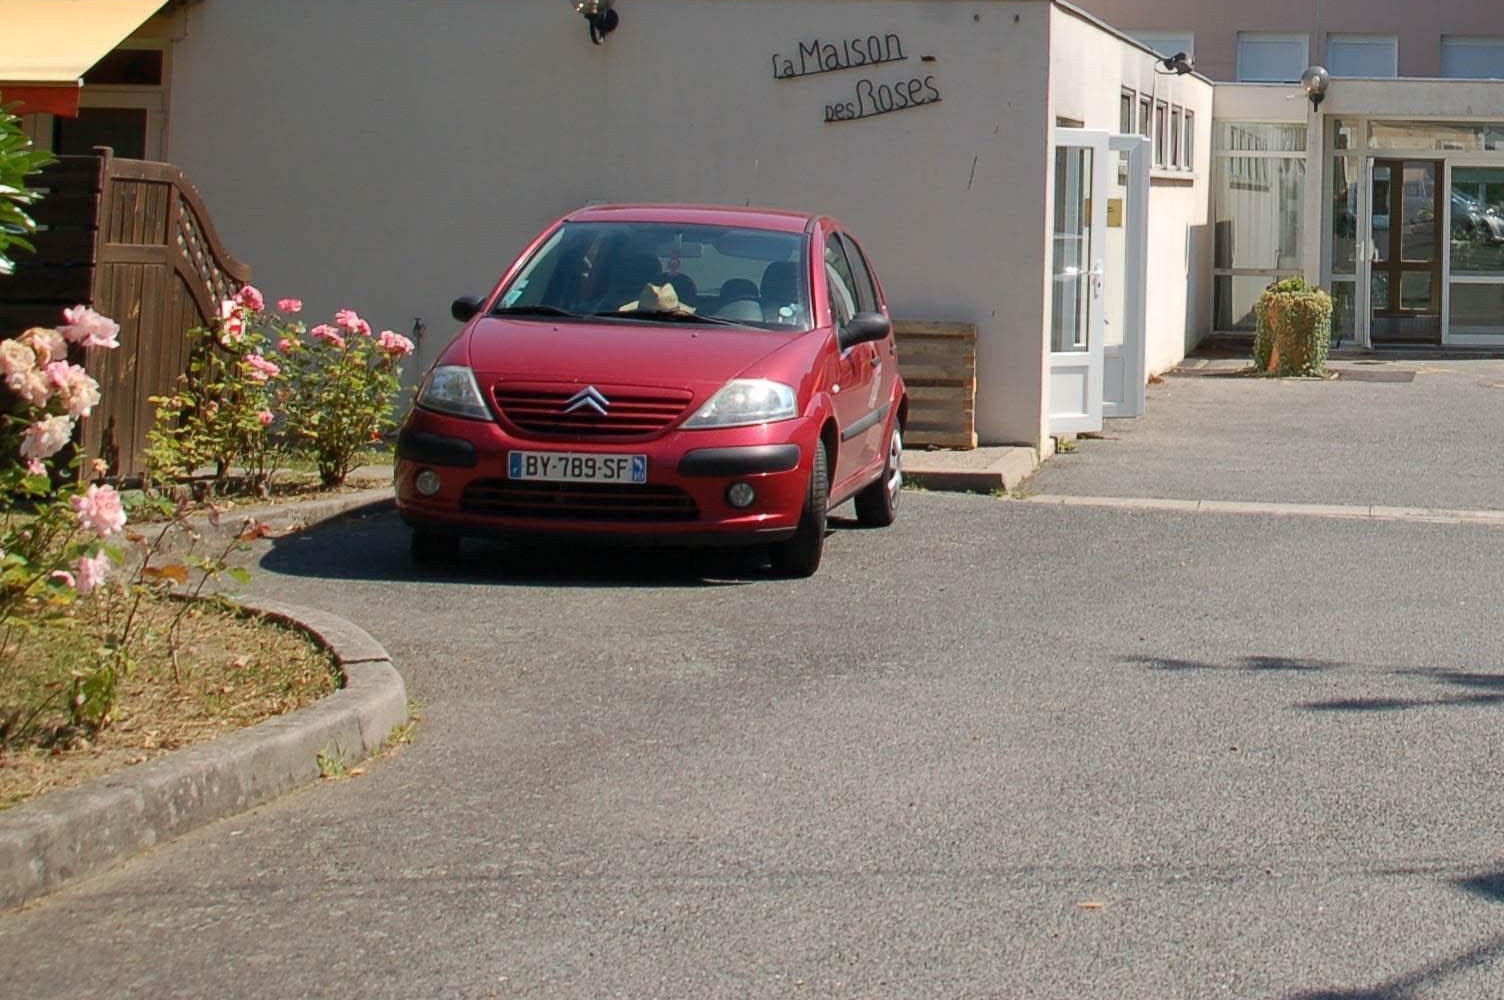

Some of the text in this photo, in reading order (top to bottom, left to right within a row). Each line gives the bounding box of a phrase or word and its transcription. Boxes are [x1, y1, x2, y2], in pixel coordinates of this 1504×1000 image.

[798, 33, 906, 75] Maison
[855, 75, 942, 119] Roses
[526, 455, 628, 479] BY-789-SF
